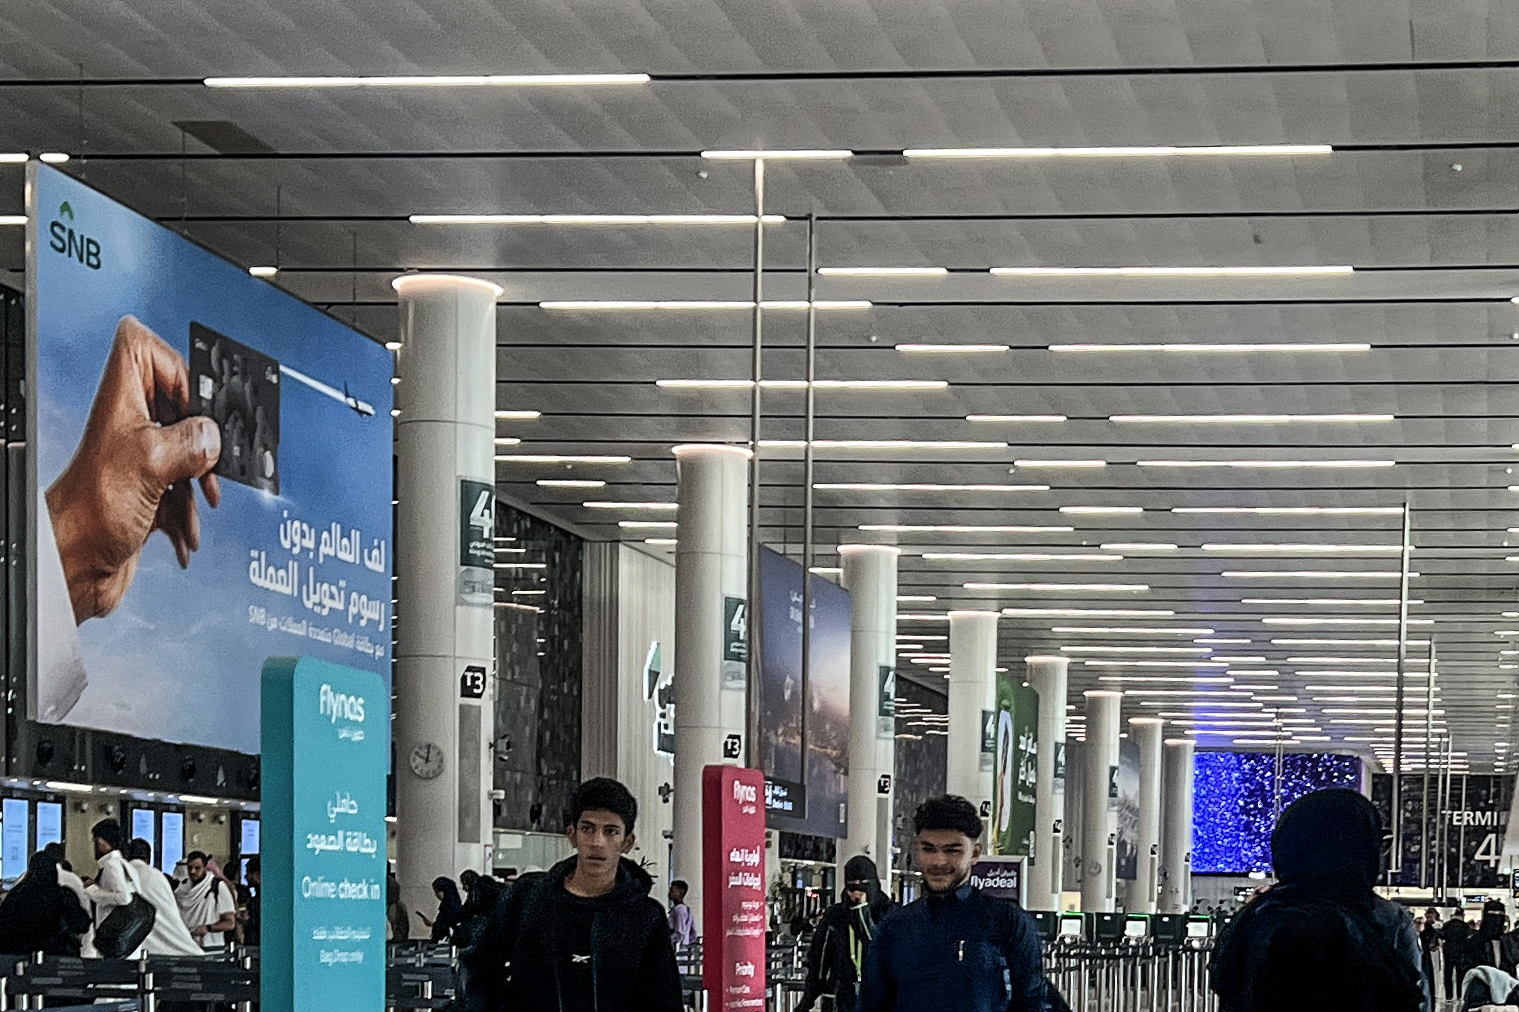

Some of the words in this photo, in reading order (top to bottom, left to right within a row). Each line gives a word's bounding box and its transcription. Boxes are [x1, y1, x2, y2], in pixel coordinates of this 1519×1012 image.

[50, 221, 101, 270] SNB
[469, 491, 496, 539] 4
[280, 509, 315, 559] بدون
[319, 521, 360, 564] العالم
[249, 549, 298, 597] العملة
[363, 538, 385, 573] لف
[303, 566, 346, 616] تحويل
[348, 591, 385, 632] رسوم
[464, 671, 484, 694] T3
[320, 683, 366, 724] flynas
[726, 737, 741, 756] T3
[1441, 810, 1498, 827] TERMI
[306, 829, 344, 856] الصعود
[346, 830, 378, 859] بطاقة
[1474, 833, 1501, 868] 4
[301, 875, 337, 899] Online
[338, 877, 369, 900] check
[369, 878, 381, 900] in
[970, 875, 1017, 890] flyadeal
